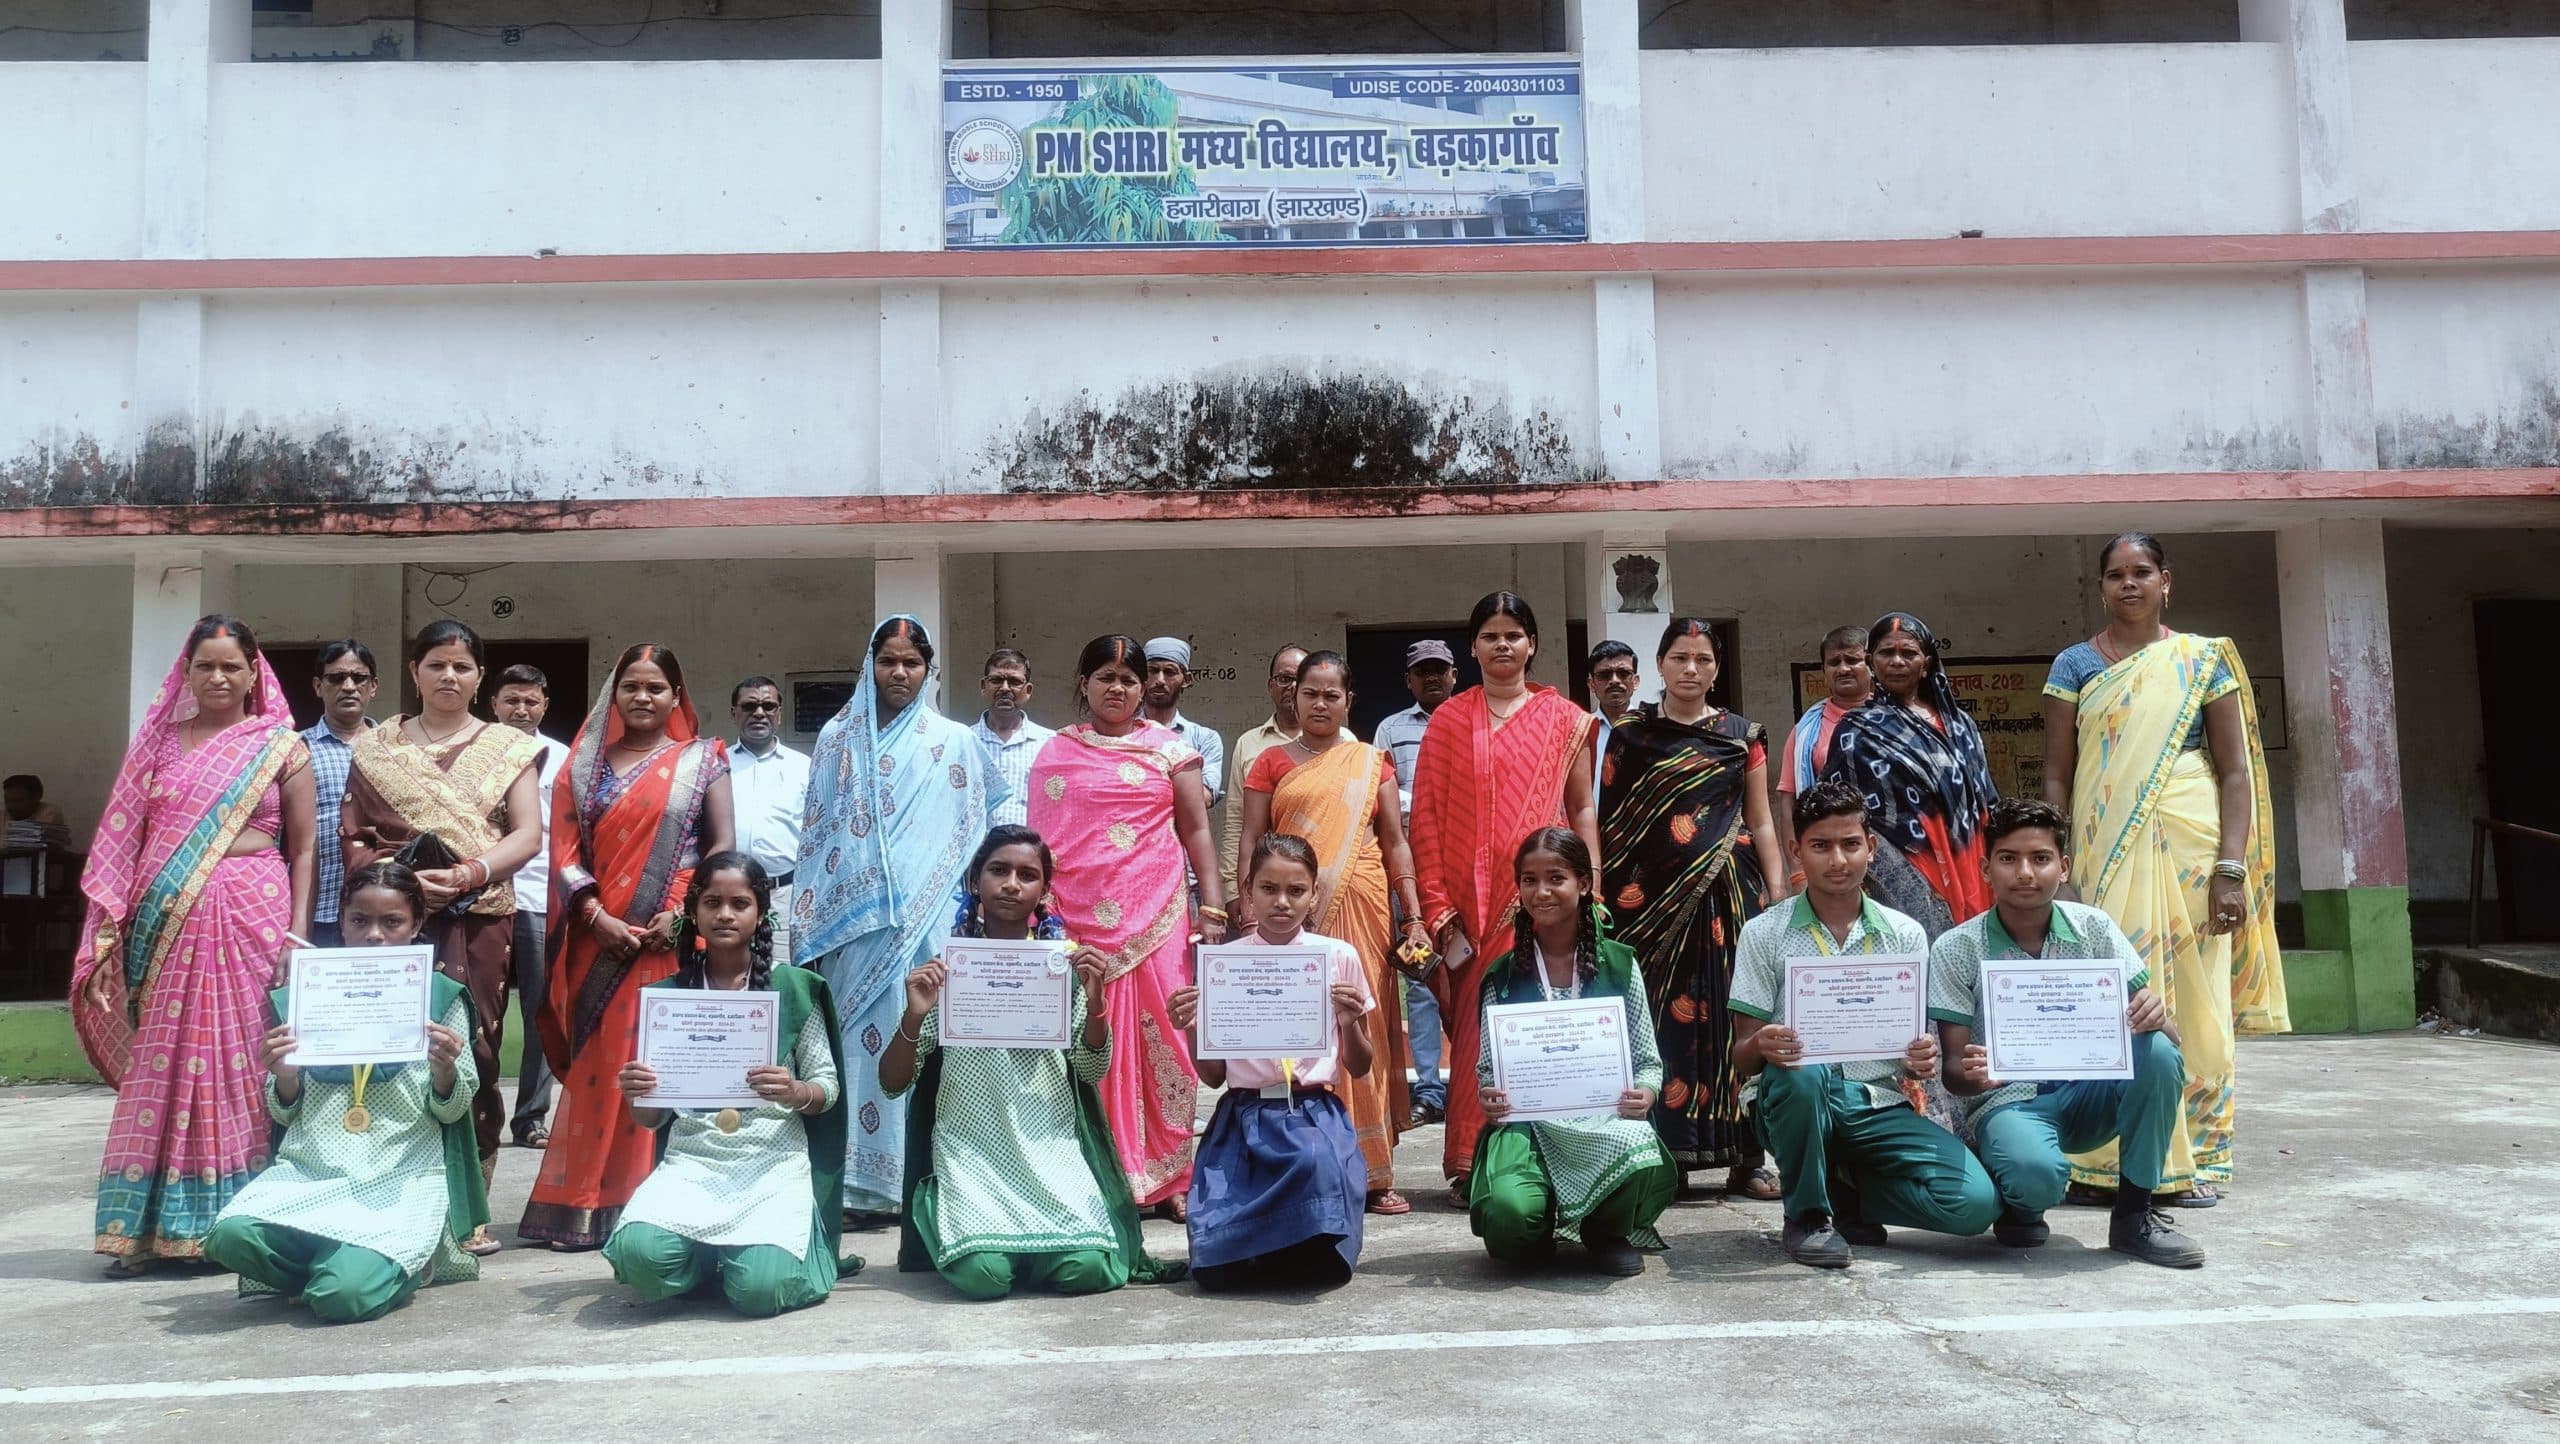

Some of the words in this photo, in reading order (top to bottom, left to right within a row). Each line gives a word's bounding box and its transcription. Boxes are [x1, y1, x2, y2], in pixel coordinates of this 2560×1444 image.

[960, 85, 1010, 98] ESTD.
[1026, 84, 1063, 97] 1950
[1350, 81, 1401, 94] UDISE
[1405, 80, 1460, 94] CODE-
[1463, 78, 1566, 93] 20040301103
[1035, 132, 1083, 174] PM
[1092, 130, 1168, 173] SHRI
[1177, 130, 1247, 170] मध्य
[1410, 115, 1560, 177] बड़कागाँव
[982, 151, 1010, 162] SHRI
[1165, 193, 1261, 220] हजारीबाग
[1267, 189, 1368, 225] (झारखण्ड)
[495, 600, 512, 615] 20
